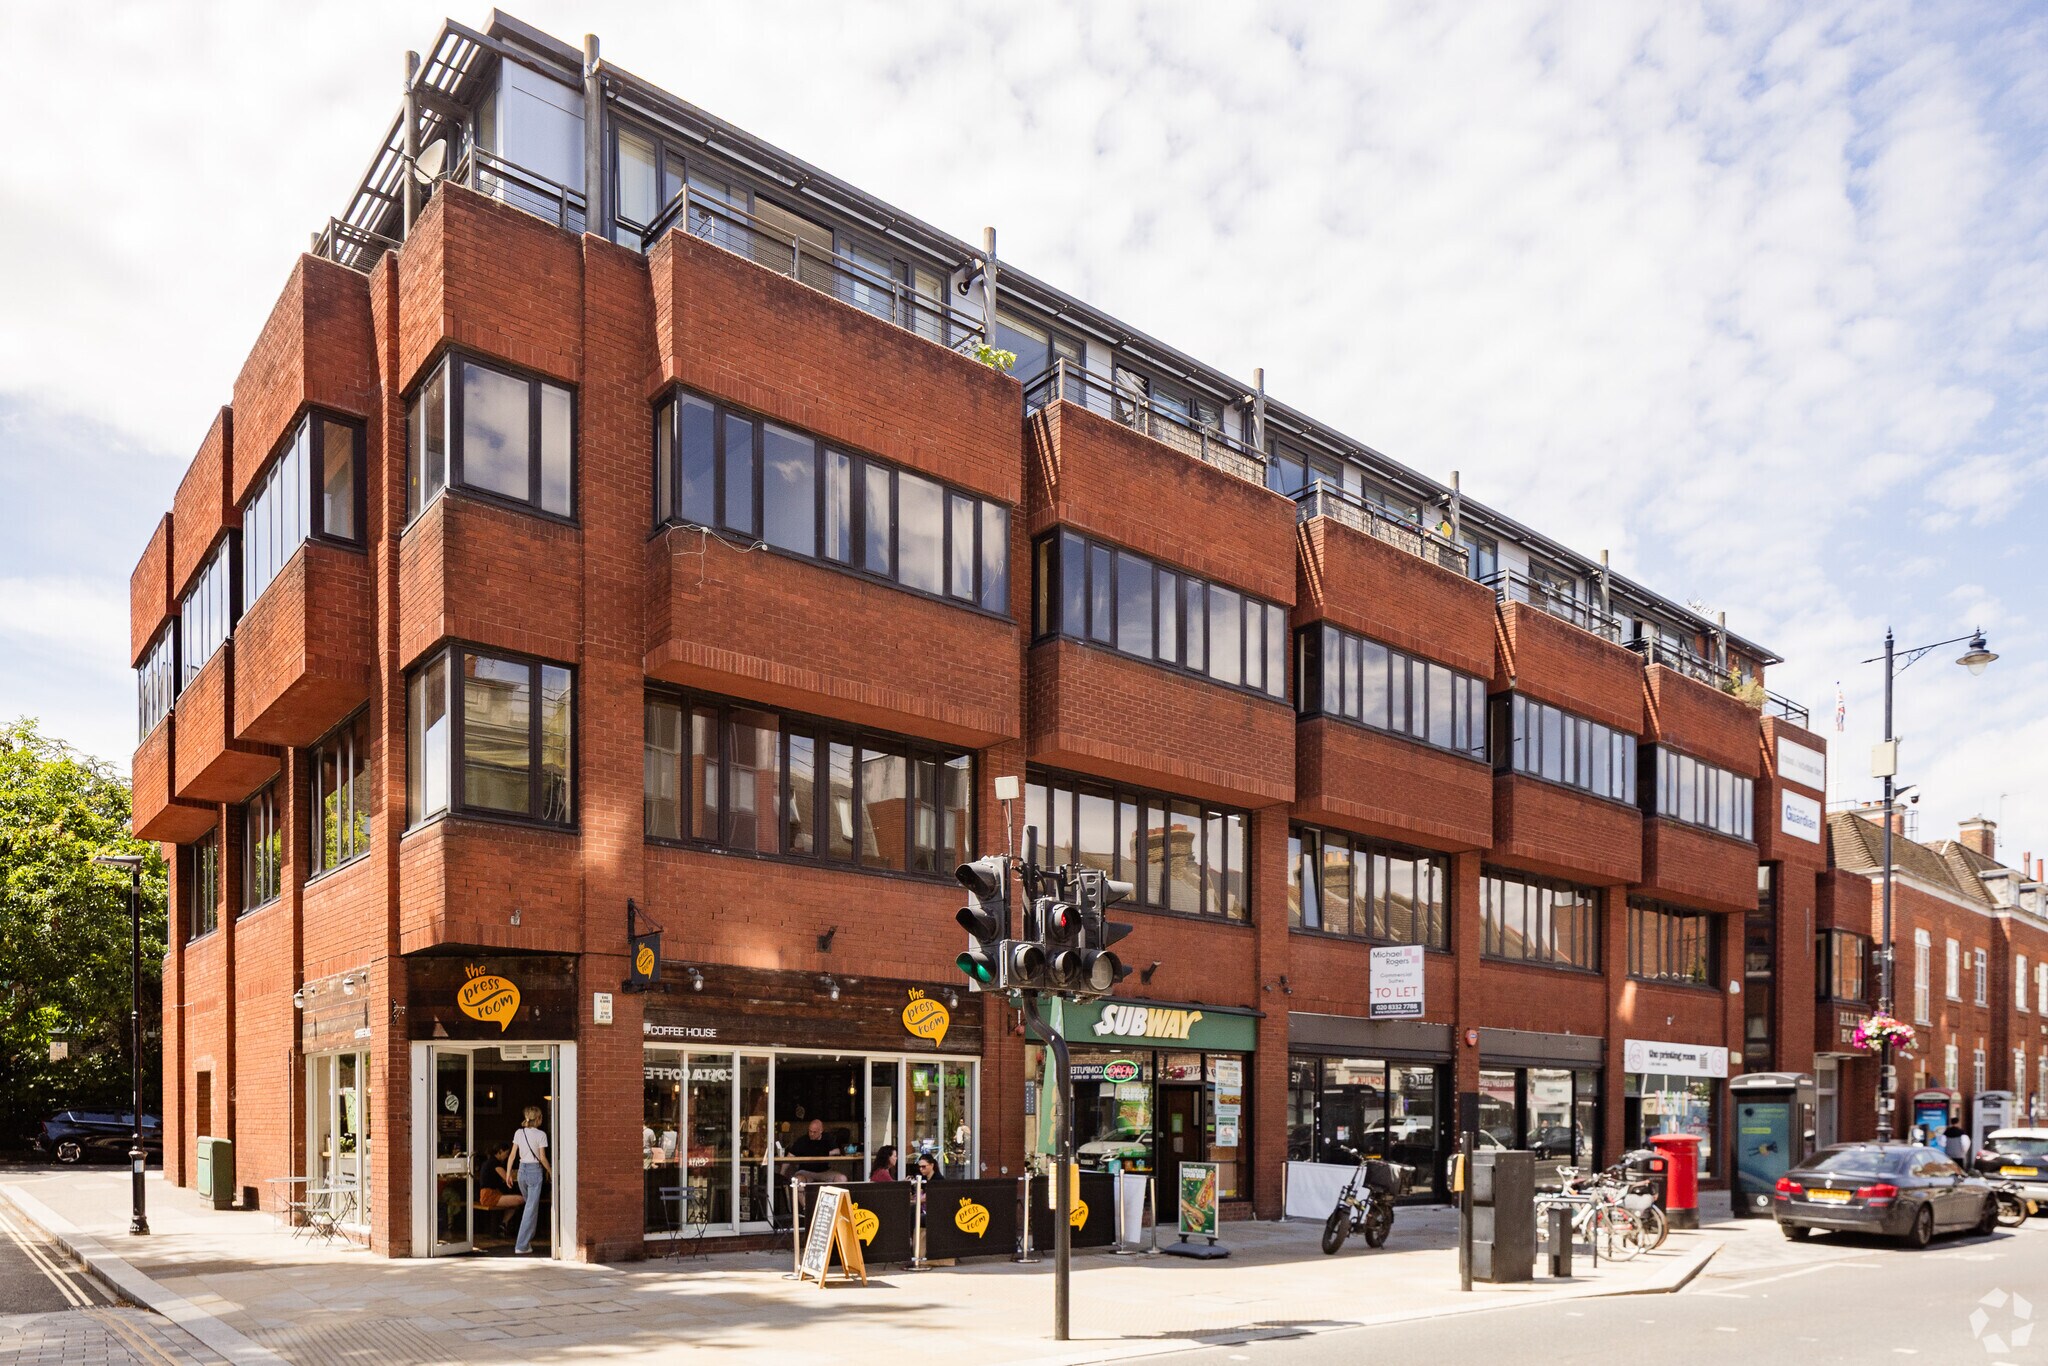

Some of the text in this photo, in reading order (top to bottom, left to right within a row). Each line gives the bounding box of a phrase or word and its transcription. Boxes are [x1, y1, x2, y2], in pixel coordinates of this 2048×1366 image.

[1786, 804, 1817, 830] Guardian
[1386, 958, 1410, 966] Rogers
[465, 962, 486, 979] the
[463, 978, 500, 1003] press
[908, 986, 925, 1001] the
[1375, 986, 1418, 998] TO LET
[477, 994, 513, 1018] room
[907, 1001, 934, 1021] press
[918, 1015, 944, 1035] room
[1093, 1004, 1203, 1040] SUBWAY
[650, 1025, 717, 1038] COFFEE HOUSE
[959, 1197, 972, 1207] the
[958, 1206, 979, 1221] press
[1071, 1209, 1085, 1222] oom
[856, 1221, 875, 1235] oom
[967, 1216, 986, 1230] room
